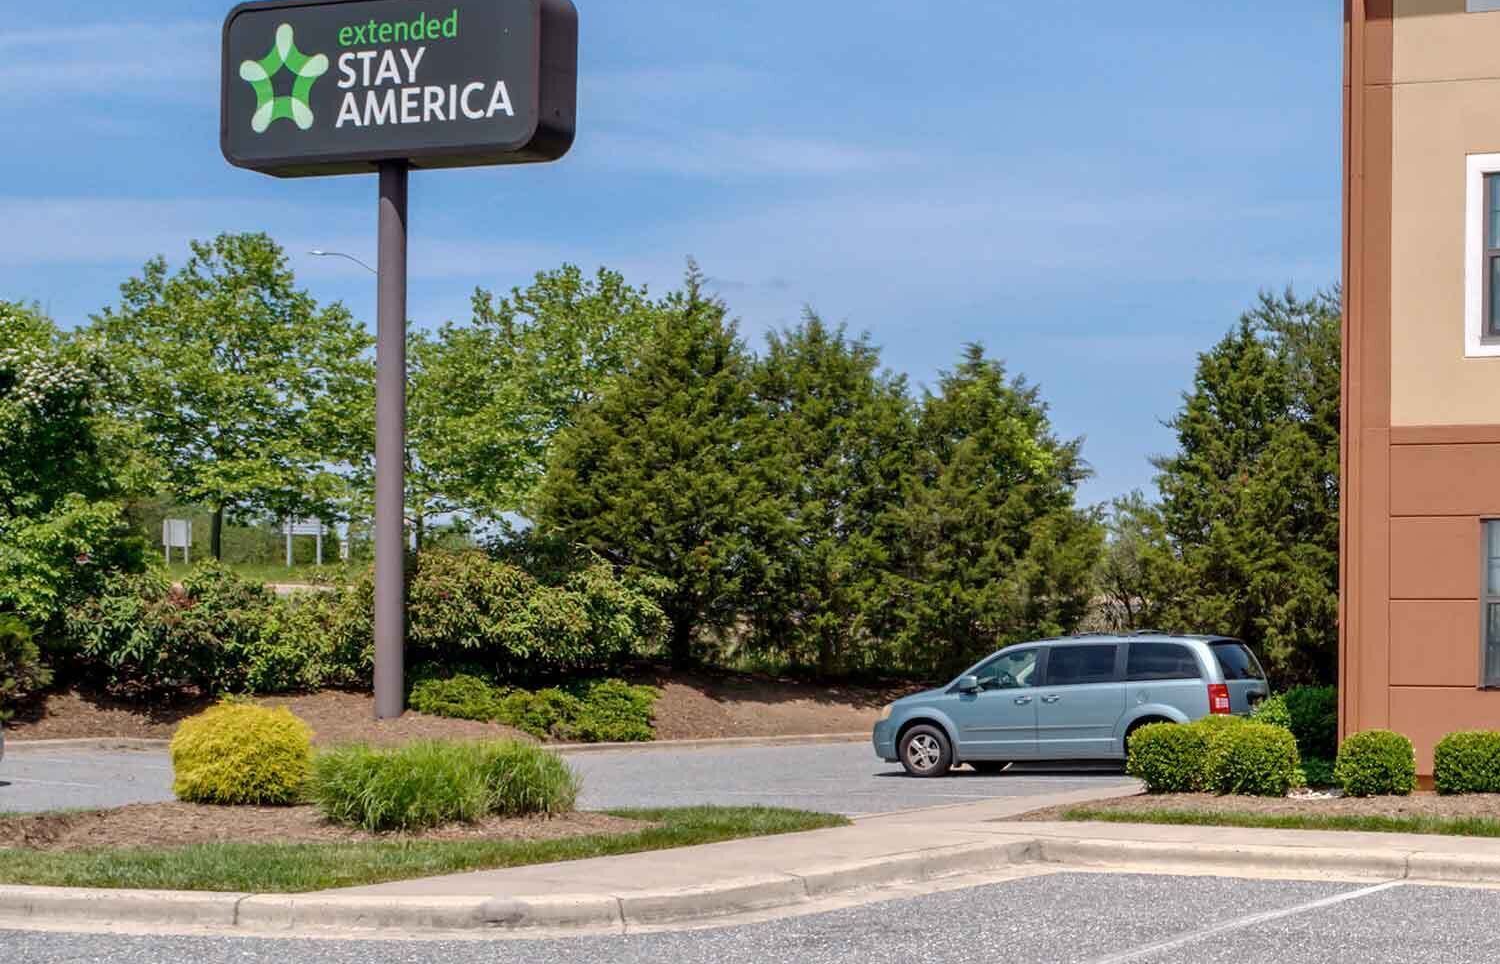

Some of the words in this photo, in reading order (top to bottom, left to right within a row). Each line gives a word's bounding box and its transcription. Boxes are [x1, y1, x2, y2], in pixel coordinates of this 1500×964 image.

[338, 9, 458, 46] extended
[337, 46, 426, 88] STAY
[335, 80, 515, 128] AMERICA
